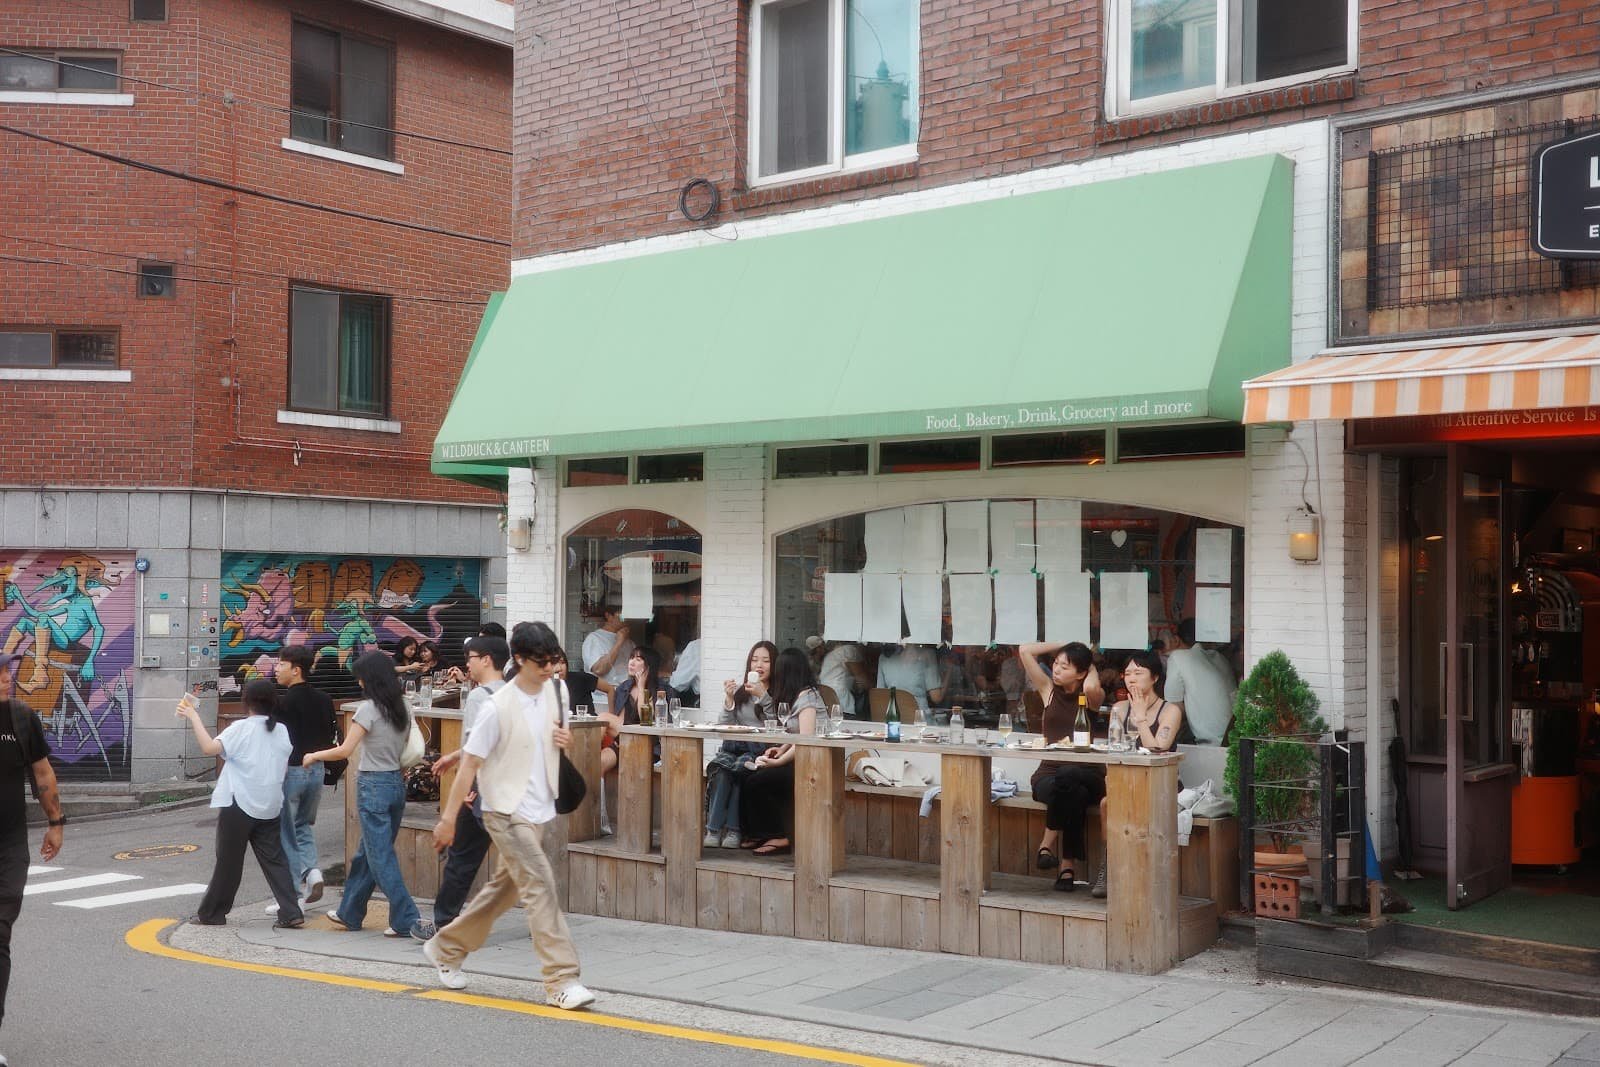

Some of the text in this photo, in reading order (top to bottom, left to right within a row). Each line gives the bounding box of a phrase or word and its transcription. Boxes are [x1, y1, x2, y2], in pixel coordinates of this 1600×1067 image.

[926, 415, 961, 431] Food,
[966, 411, 1014, 429] Bakery,
[1121, 400, 1149, 418] and
[1153, 400, 1193, 415] more
[1456, 411, 1520, 427] Attentive
[1522, 408, 1575, 424] Service
[441, 438, 550, 458] WILDDUCK&CANTEEN
